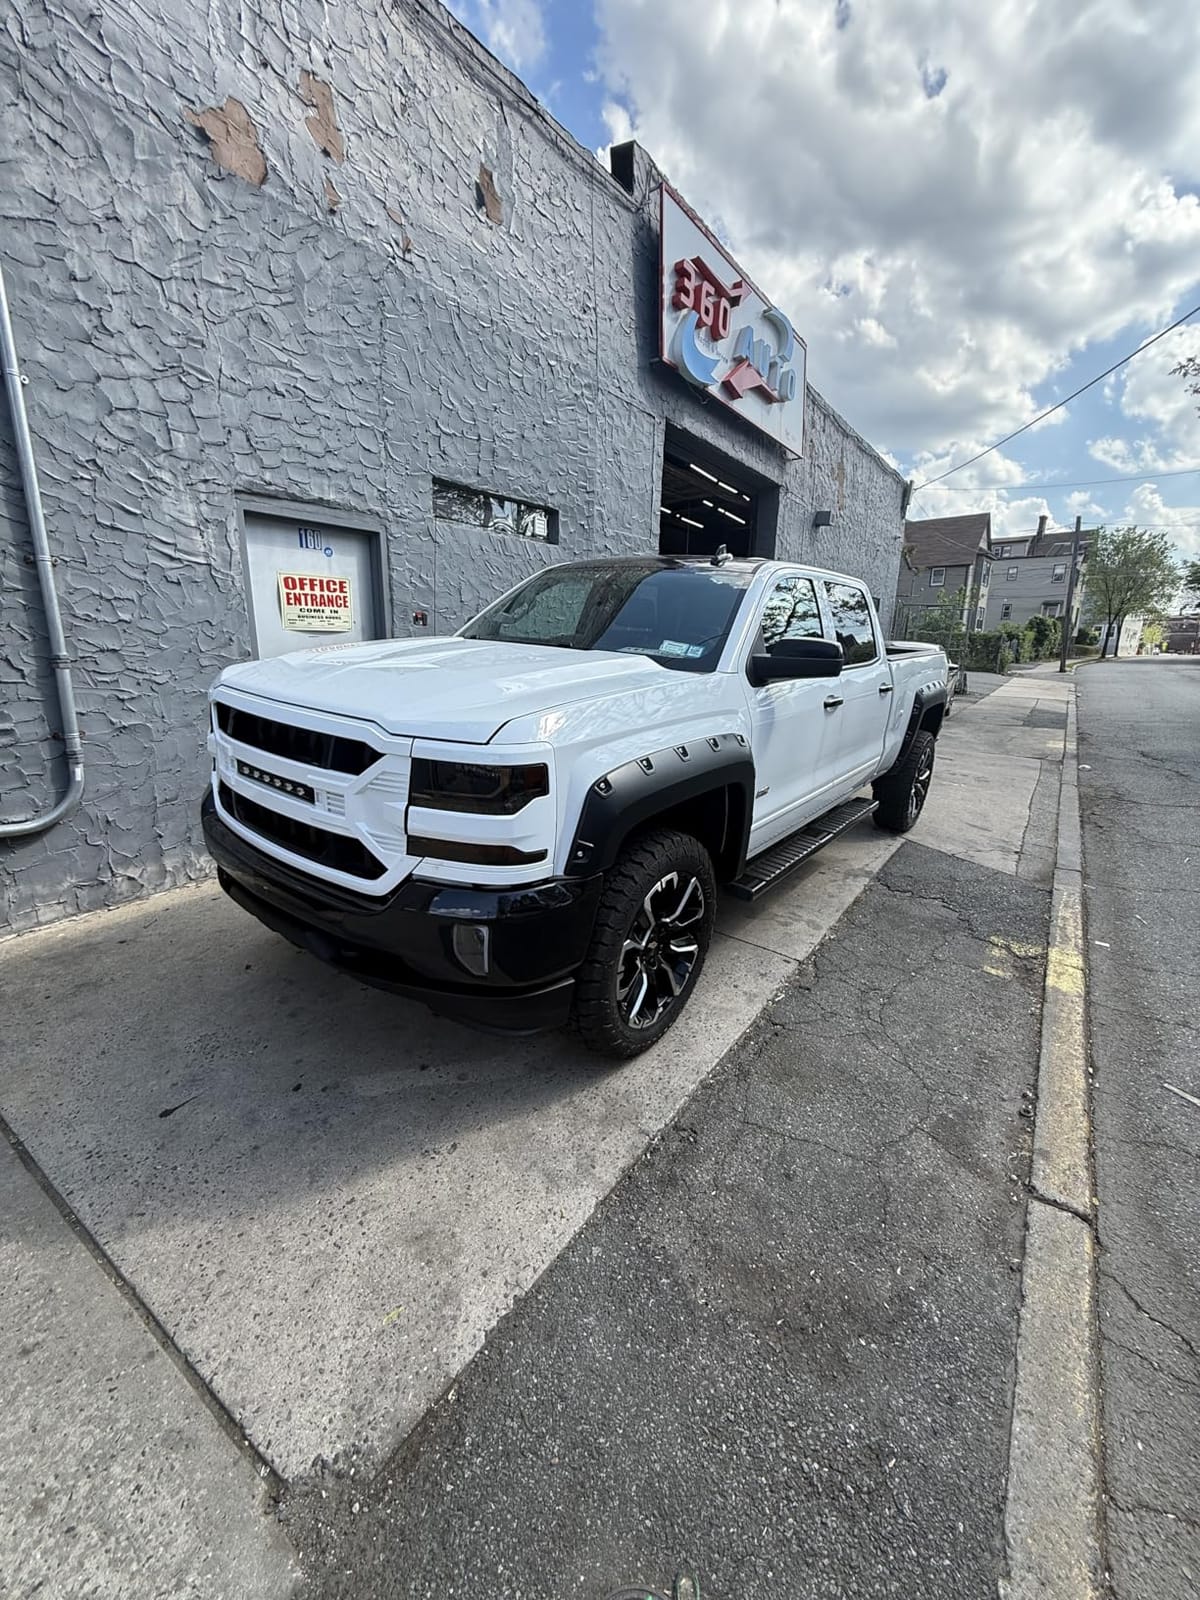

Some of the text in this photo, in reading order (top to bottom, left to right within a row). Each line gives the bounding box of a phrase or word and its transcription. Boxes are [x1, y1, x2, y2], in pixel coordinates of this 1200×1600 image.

[672, 258, 731, 341] 360
[300, 529, 321, 550] 160
[283, 576, 348, 594] OFFICE
[285, 591, 349, 608] ENTRANCE
